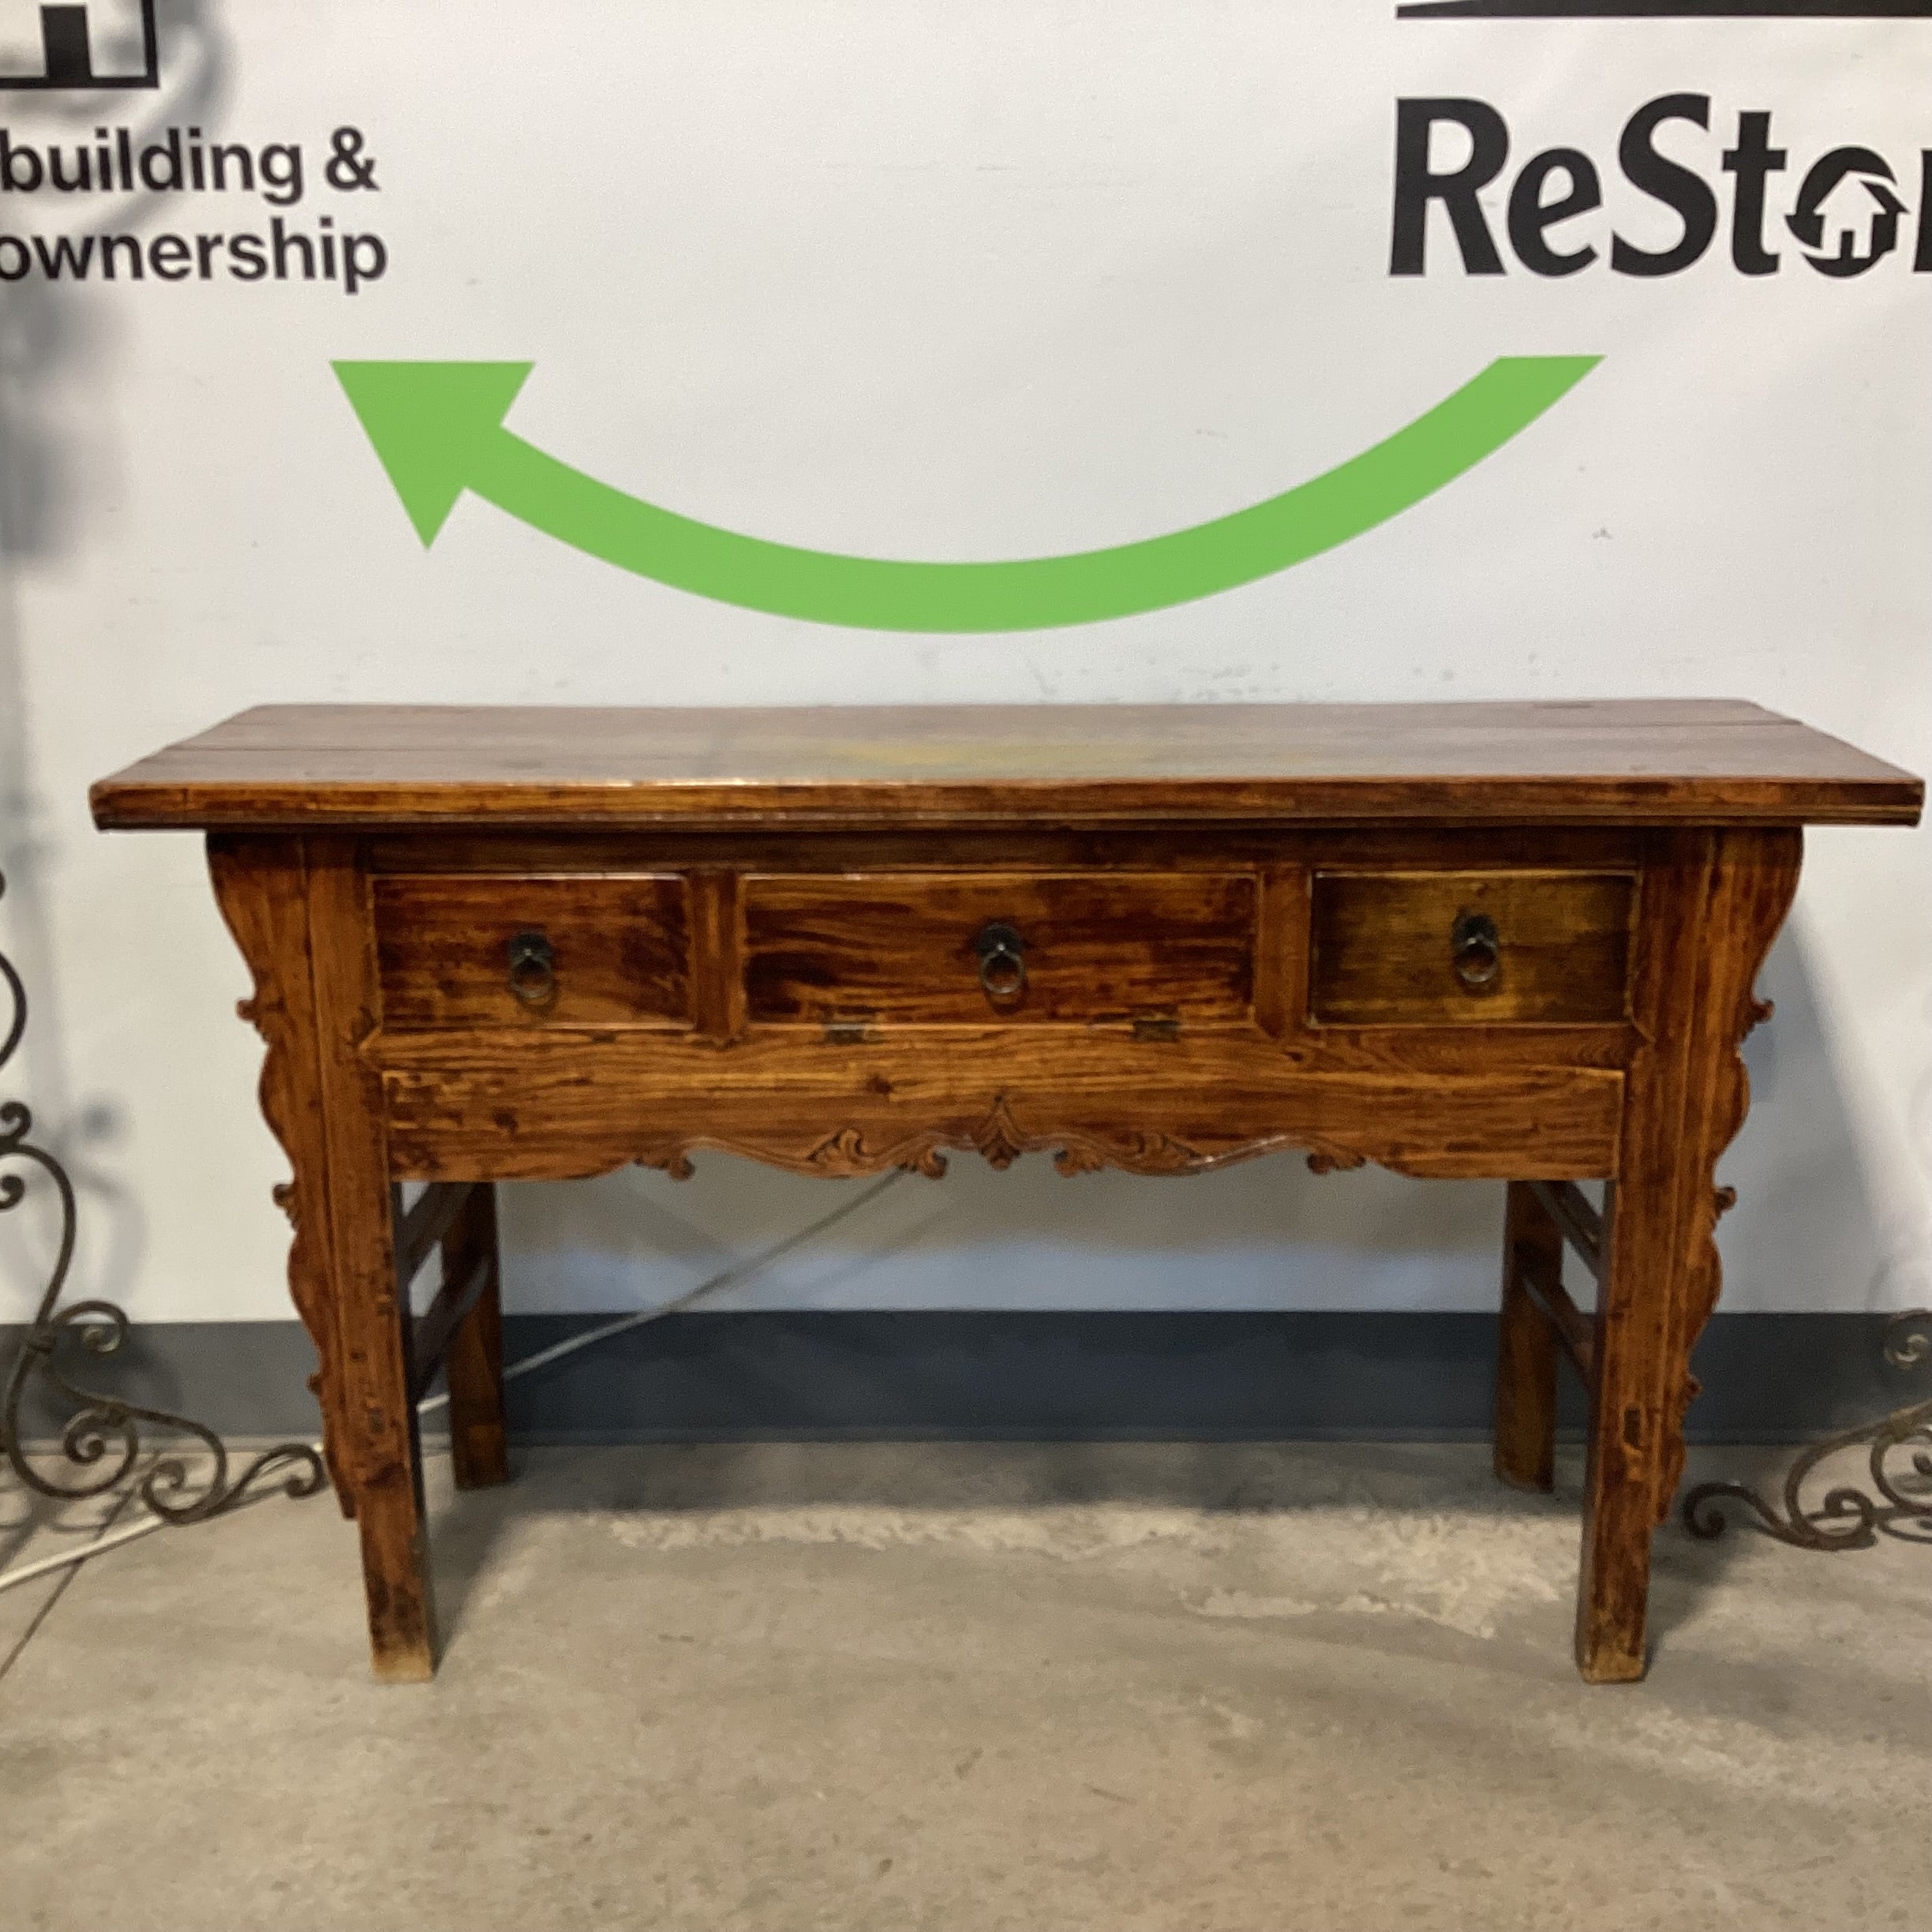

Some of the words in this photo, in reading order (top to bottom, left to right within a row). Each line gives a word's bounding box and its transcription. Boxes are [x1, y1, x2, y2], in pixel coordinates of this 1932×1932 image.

[0, 127, 303, 205] building
[325, 126, 380, 191] &
[1389, 92, 1932, 278] ReSto
[0, 216, 388, 294] ownership
